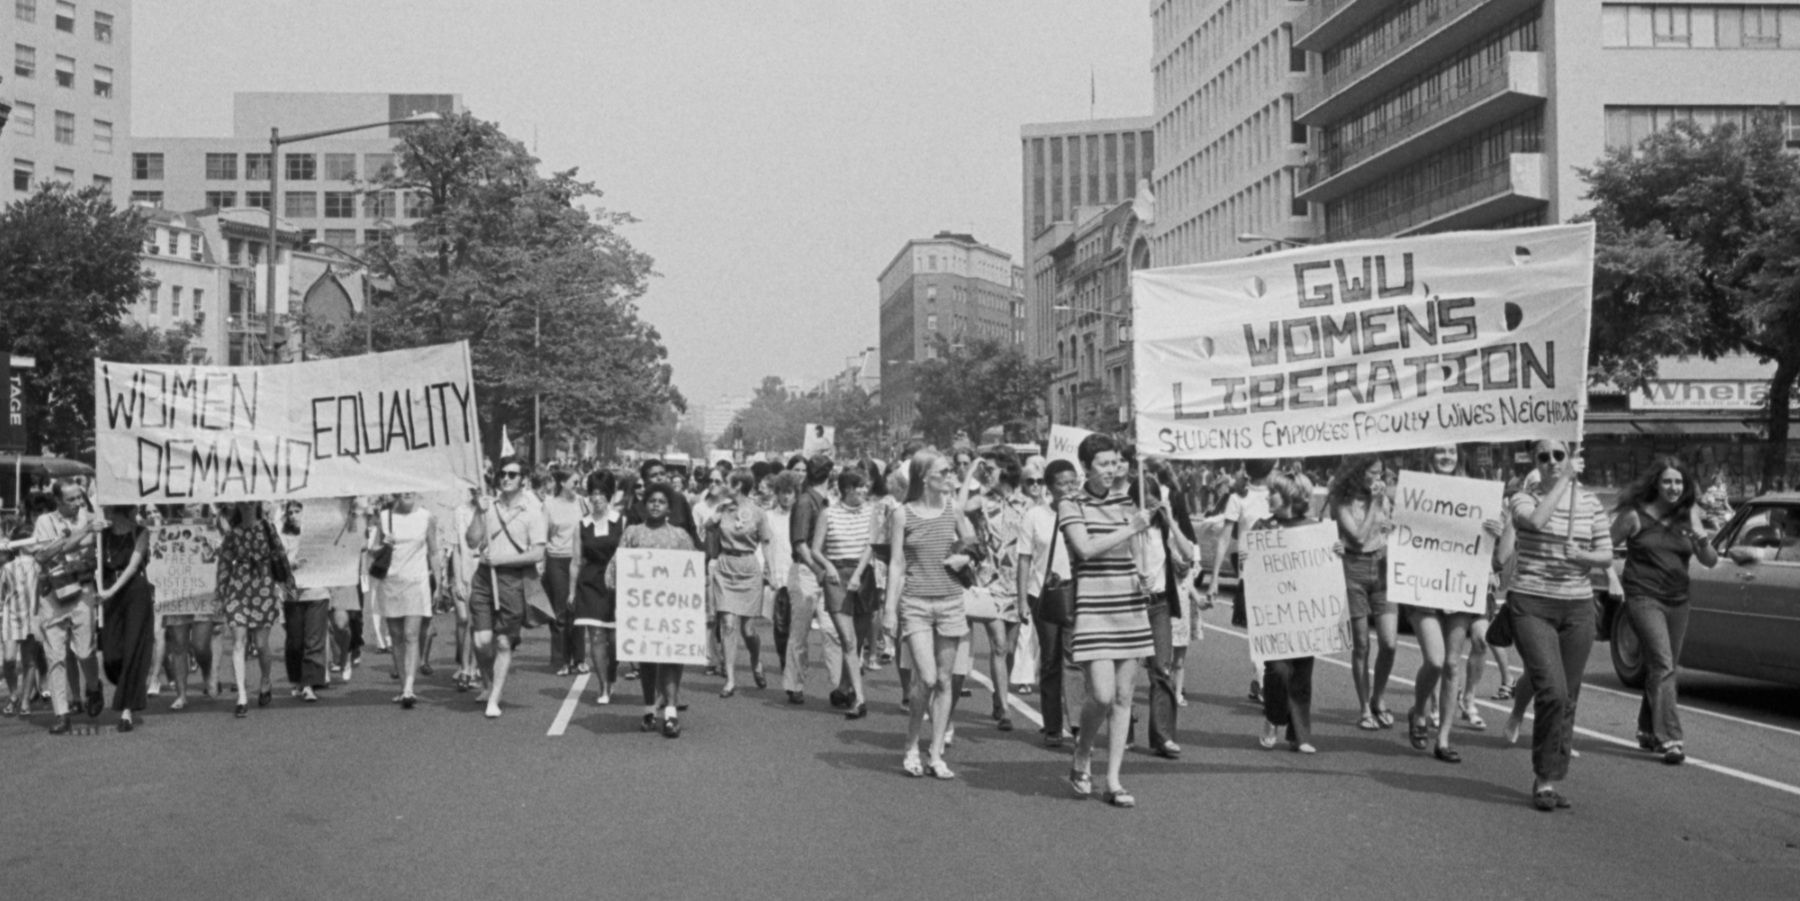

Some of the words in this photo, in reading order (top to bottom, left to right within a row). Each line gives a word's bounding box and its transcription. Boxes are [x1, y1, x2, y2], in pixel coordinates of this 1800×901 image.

[1293, 252, 1415, 308] GWU
[1243, 294, 1477, 367] WOMEN'S
[1172, 340, 1555, 420] LIBERATION
[1640, 381, 1768, 402] Whela
[103, 364, 258, 431] WOMEN
[311, 381, 471, 462] EQUALITY
[1053, 435, 1074, 454] Wo
[137, 434, 312, 499] DEMAND
[1402, 487, 1483, 519] Women
[1246, 529, 1287, 552] FREE
[1397, 524, 1481, 557] Demand
[627, 551, 670, 579] I'm
[683, 558, 697, 578] A
[1262, 547, 1334, 573] ABORTION
[627, 588, 702, 609] SECOND
[1277, 580, 1297, 594] ON
[1393, 561, 1477, 608] Equality
[626, 616, 695, 634] CLASS
[1252, 594, 1341, 627] DEMAND
